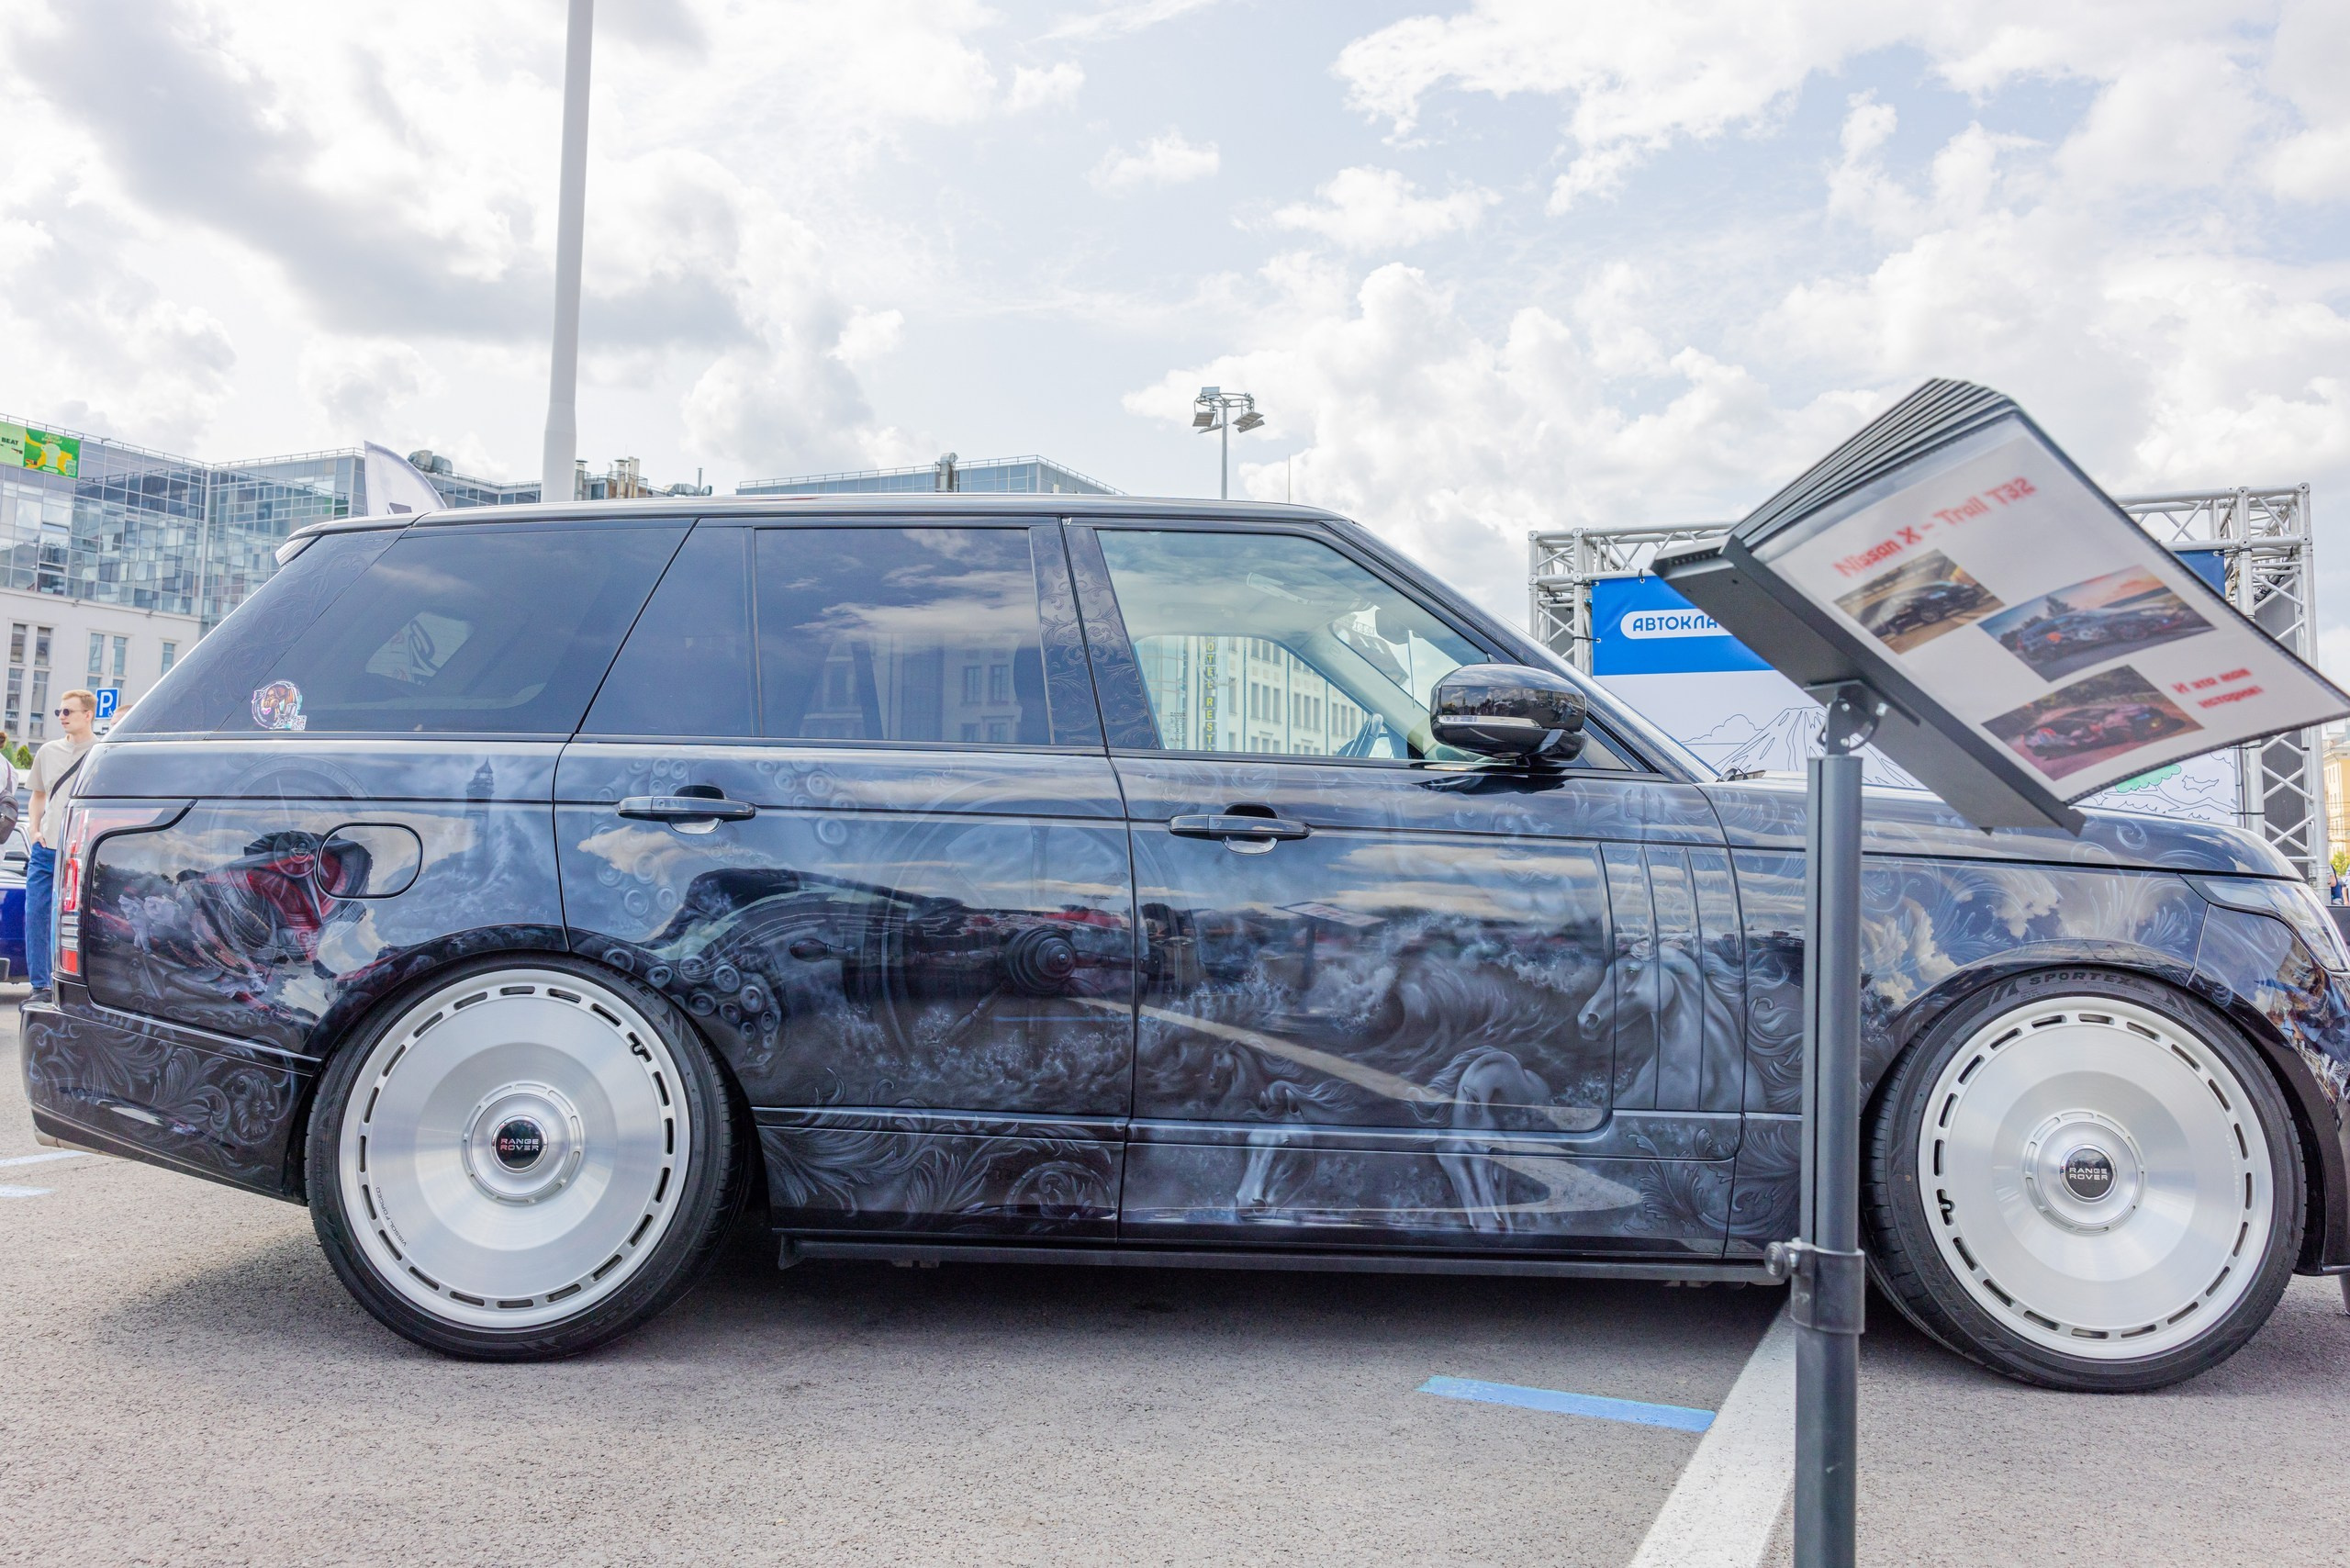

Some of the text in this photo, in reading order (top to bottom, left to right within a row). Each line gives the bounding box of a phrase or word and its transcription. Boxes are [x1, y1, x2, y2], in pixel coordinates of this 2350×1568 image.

[2, 437, 18, 445] BEAT
[1832, 538, 1902, 577] Nissan
[1896, 525, 1923, 545] X
[1933, 497, 1989, 527] Trail
[1984, 476, 2037, 507] T32
[1205, 636, 1214, 689] OTEL
[99, 691, 113, 716] P
[2029, 971, 2132, 987] SPORTEX
